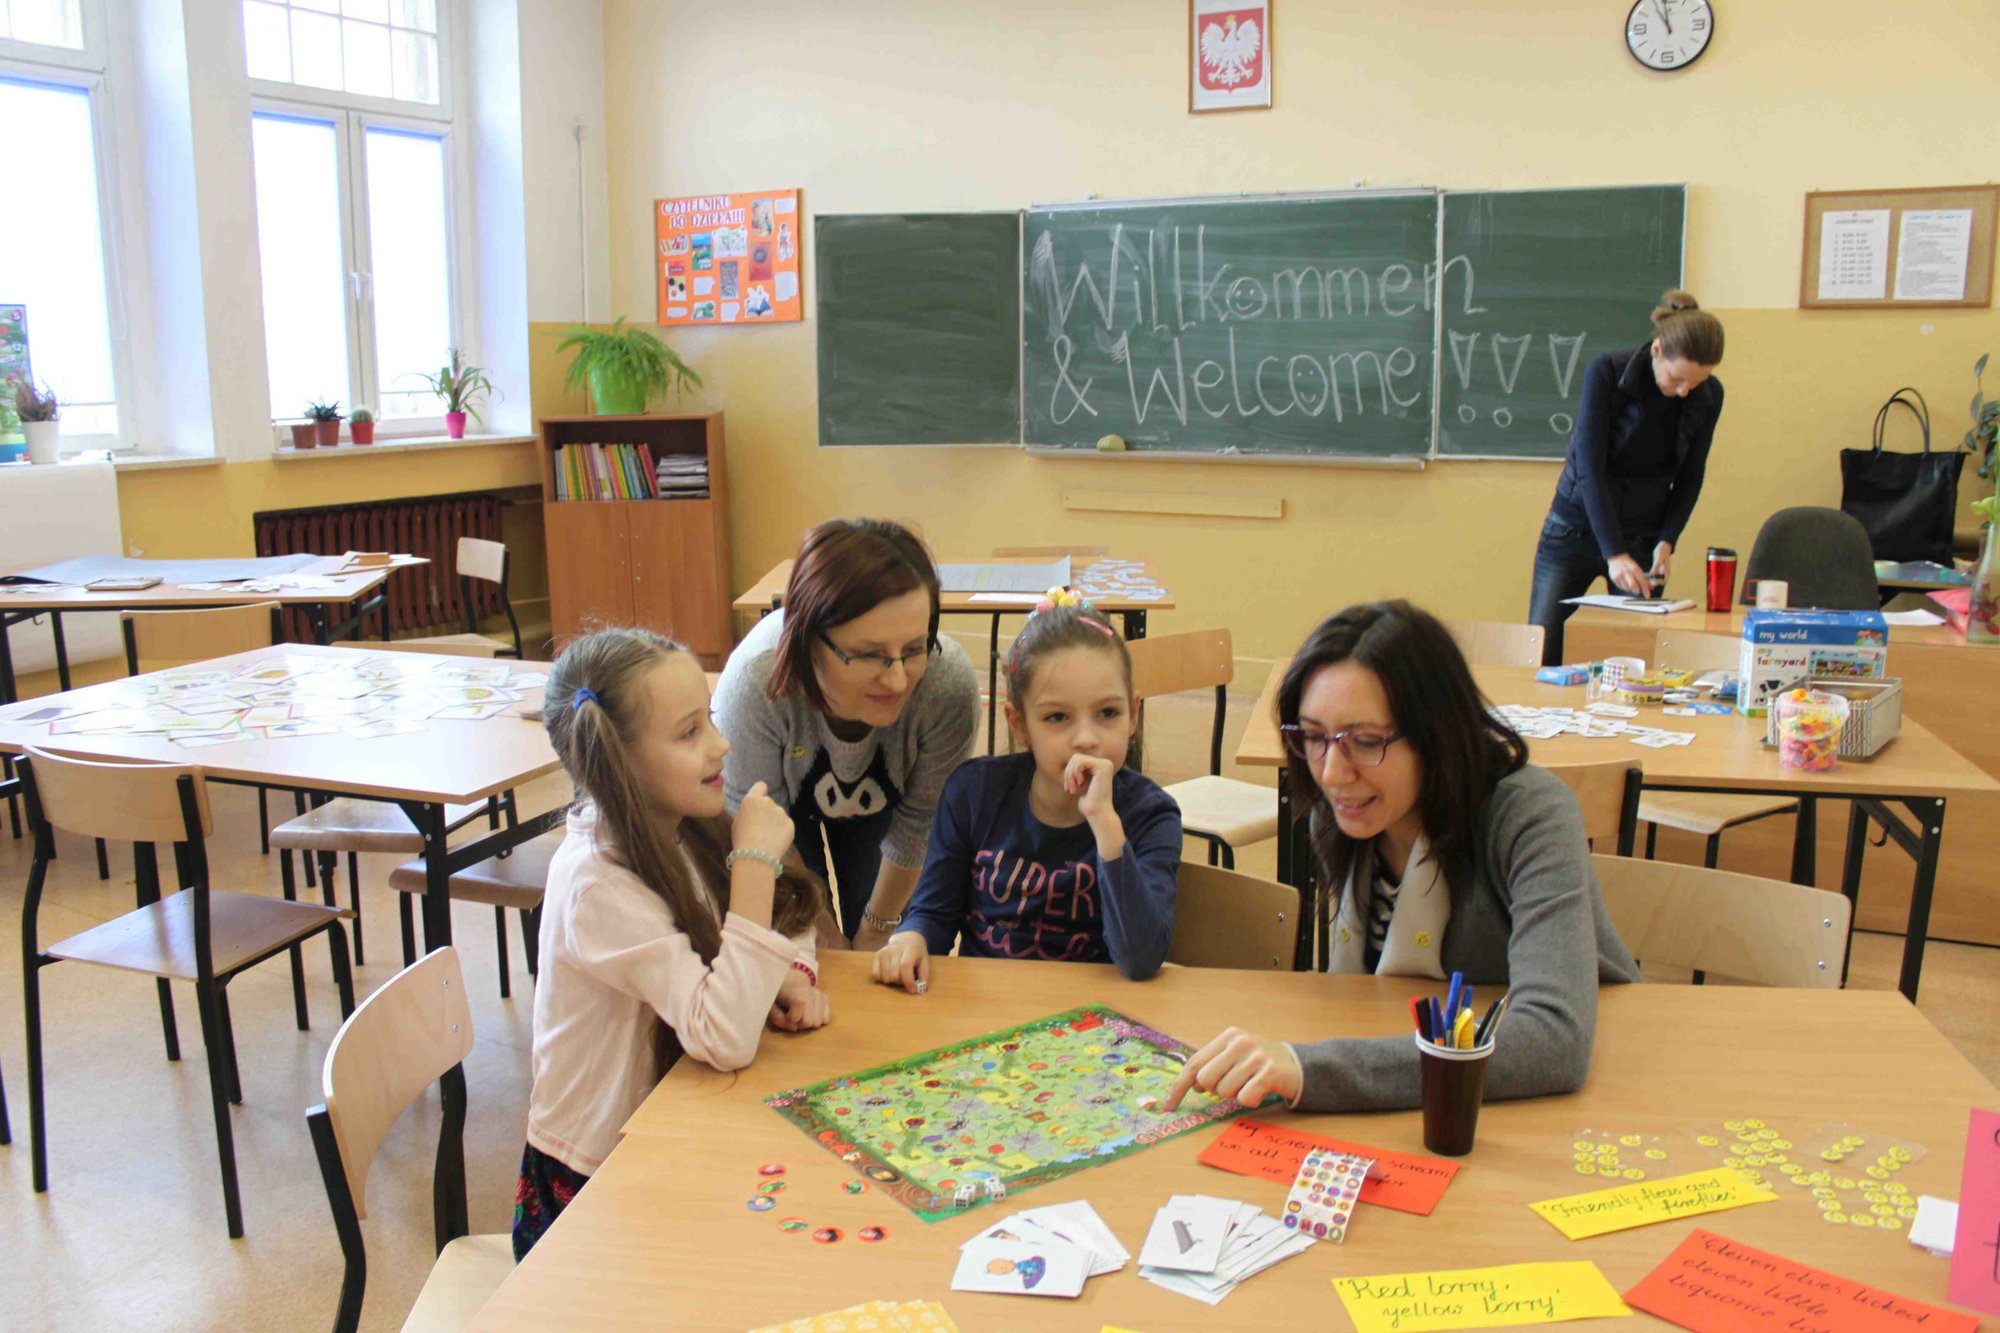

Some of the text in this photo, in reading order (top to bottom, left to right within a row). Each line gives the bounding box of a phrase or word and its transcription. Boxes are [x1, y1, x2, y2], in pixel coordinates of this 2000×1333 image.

[1633, 23, 1647, 35] 9
[1692, 19, 1705, 32] 3
[1661, 51, 1674, 63] 6
[671, 215, 686, 229] DO
[1033, 223, 1487, 332] Willkommen
[1051, 335, 1097, 424] &
[1111, 327, 1421, 426] Welcome
[1759, 629, 1808, 642] my world
[1757, 656, 1806, 668] farmyard
[971, 848, 1096, 921] SUPER
[1249, 1148, 1279, 1160] all
[1685, 1178, 1723, 1192] and
[1682, 1259, 1829, 1316] eleven little
[1784, 1271, 1841, 1295] elves
[1382, 1301, 1464, 1329] yellow
